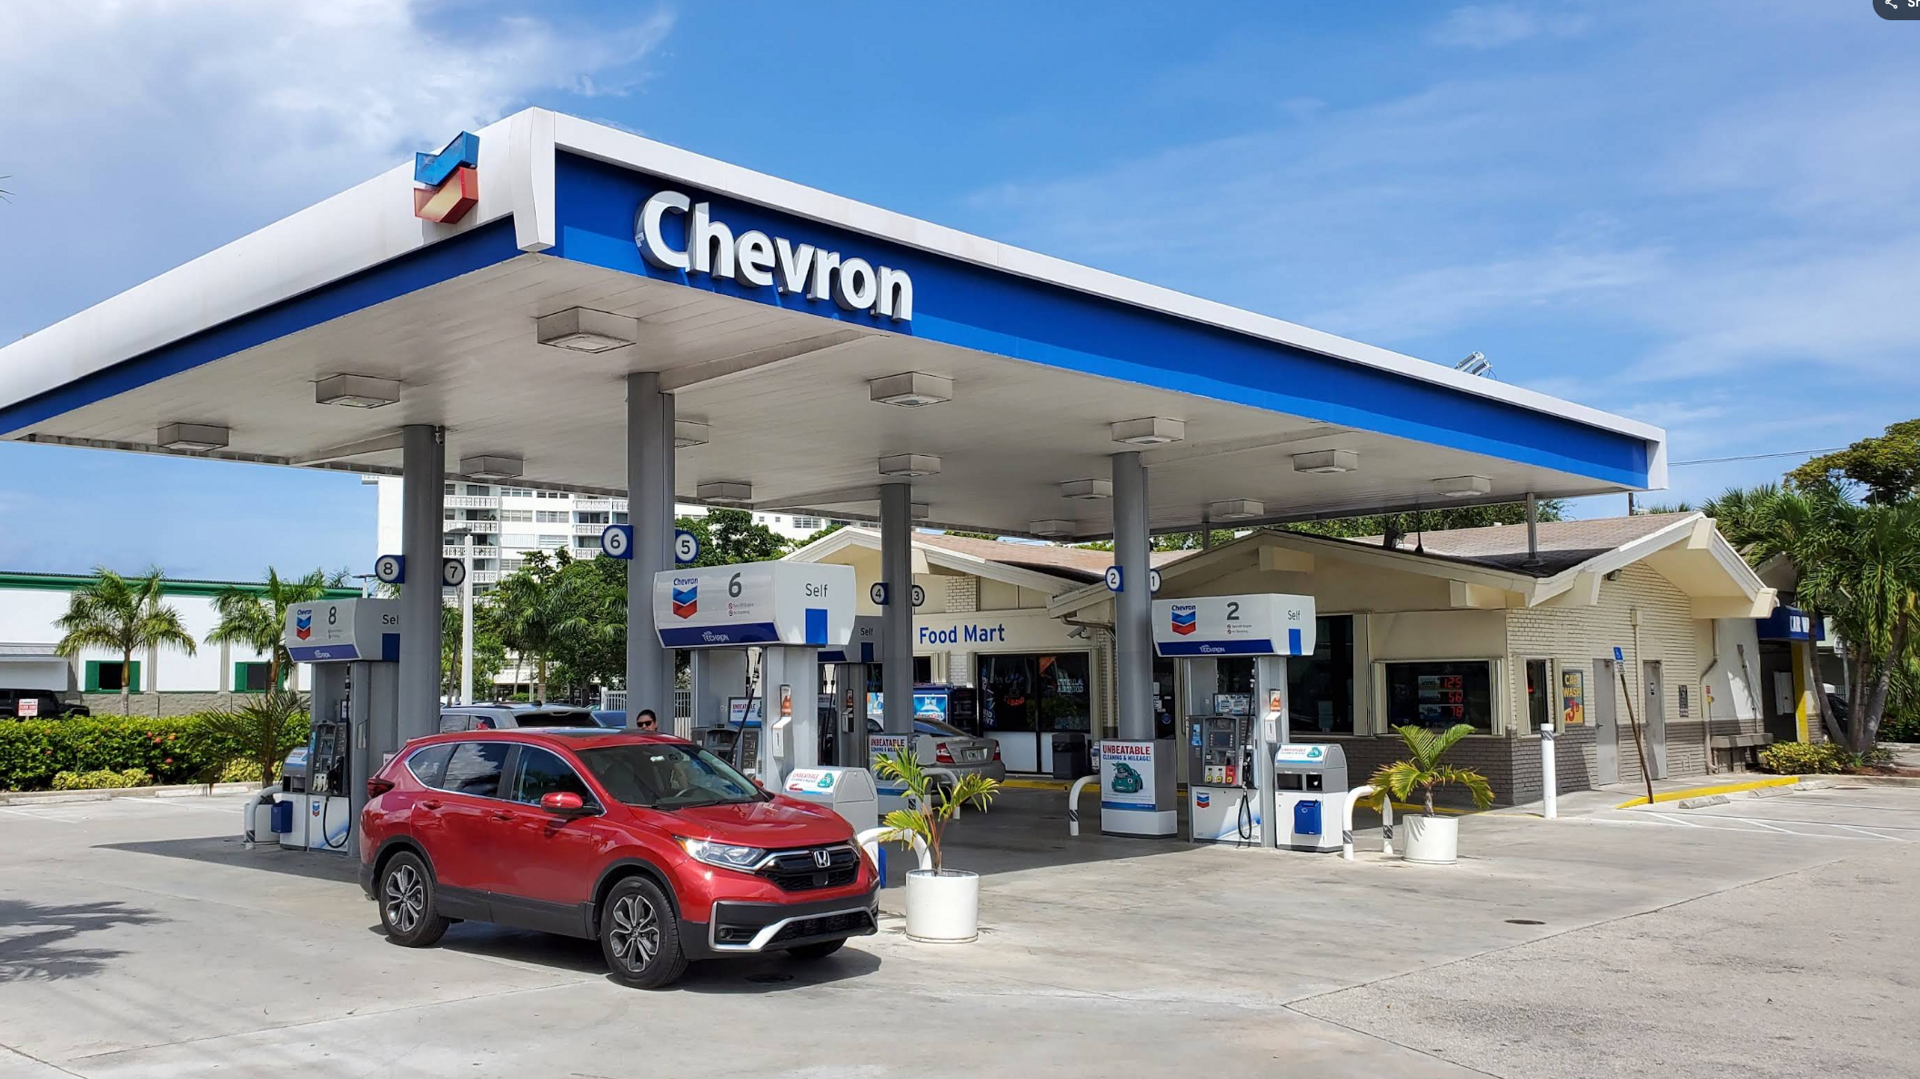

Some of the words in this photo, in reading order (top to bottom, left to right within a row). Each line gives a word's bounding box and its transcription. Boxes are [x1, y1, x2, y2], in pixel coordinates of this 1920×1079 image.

[635, 190, 913, 321] Chevron
[610, 533, 621, 549] 6
[681, 539, 691, 555] 5
[383, 562, 393, 575] 8
[449, 565, 458, 579] 7
[673, 578, 698, 586] Chevron
[728, 572, 742, 598] 6
[1110, 572, 1117, 585] 2
[805, 583, 828, 598] Self
[875, 588, 882, 599] 4
[913, 590, 920, 601] 3
[328, 606, 337, 625] 8
[1226, 602, 1240, 620] 2
[1287, 610, 1300, 621] Self
[382, 614, 400, 625] Sel
[860, 627, 874, 636] Self
[920, 625, 958, 644] Food
[964, 623, 1005, 642] Mart
[1445, 677, 1462, 688] 125
[1564, 674, 1577, 685] CAR
[1563, 687, 1581, 697] WASH
[1102, 745, 1151, 755] UNBEATABLE
